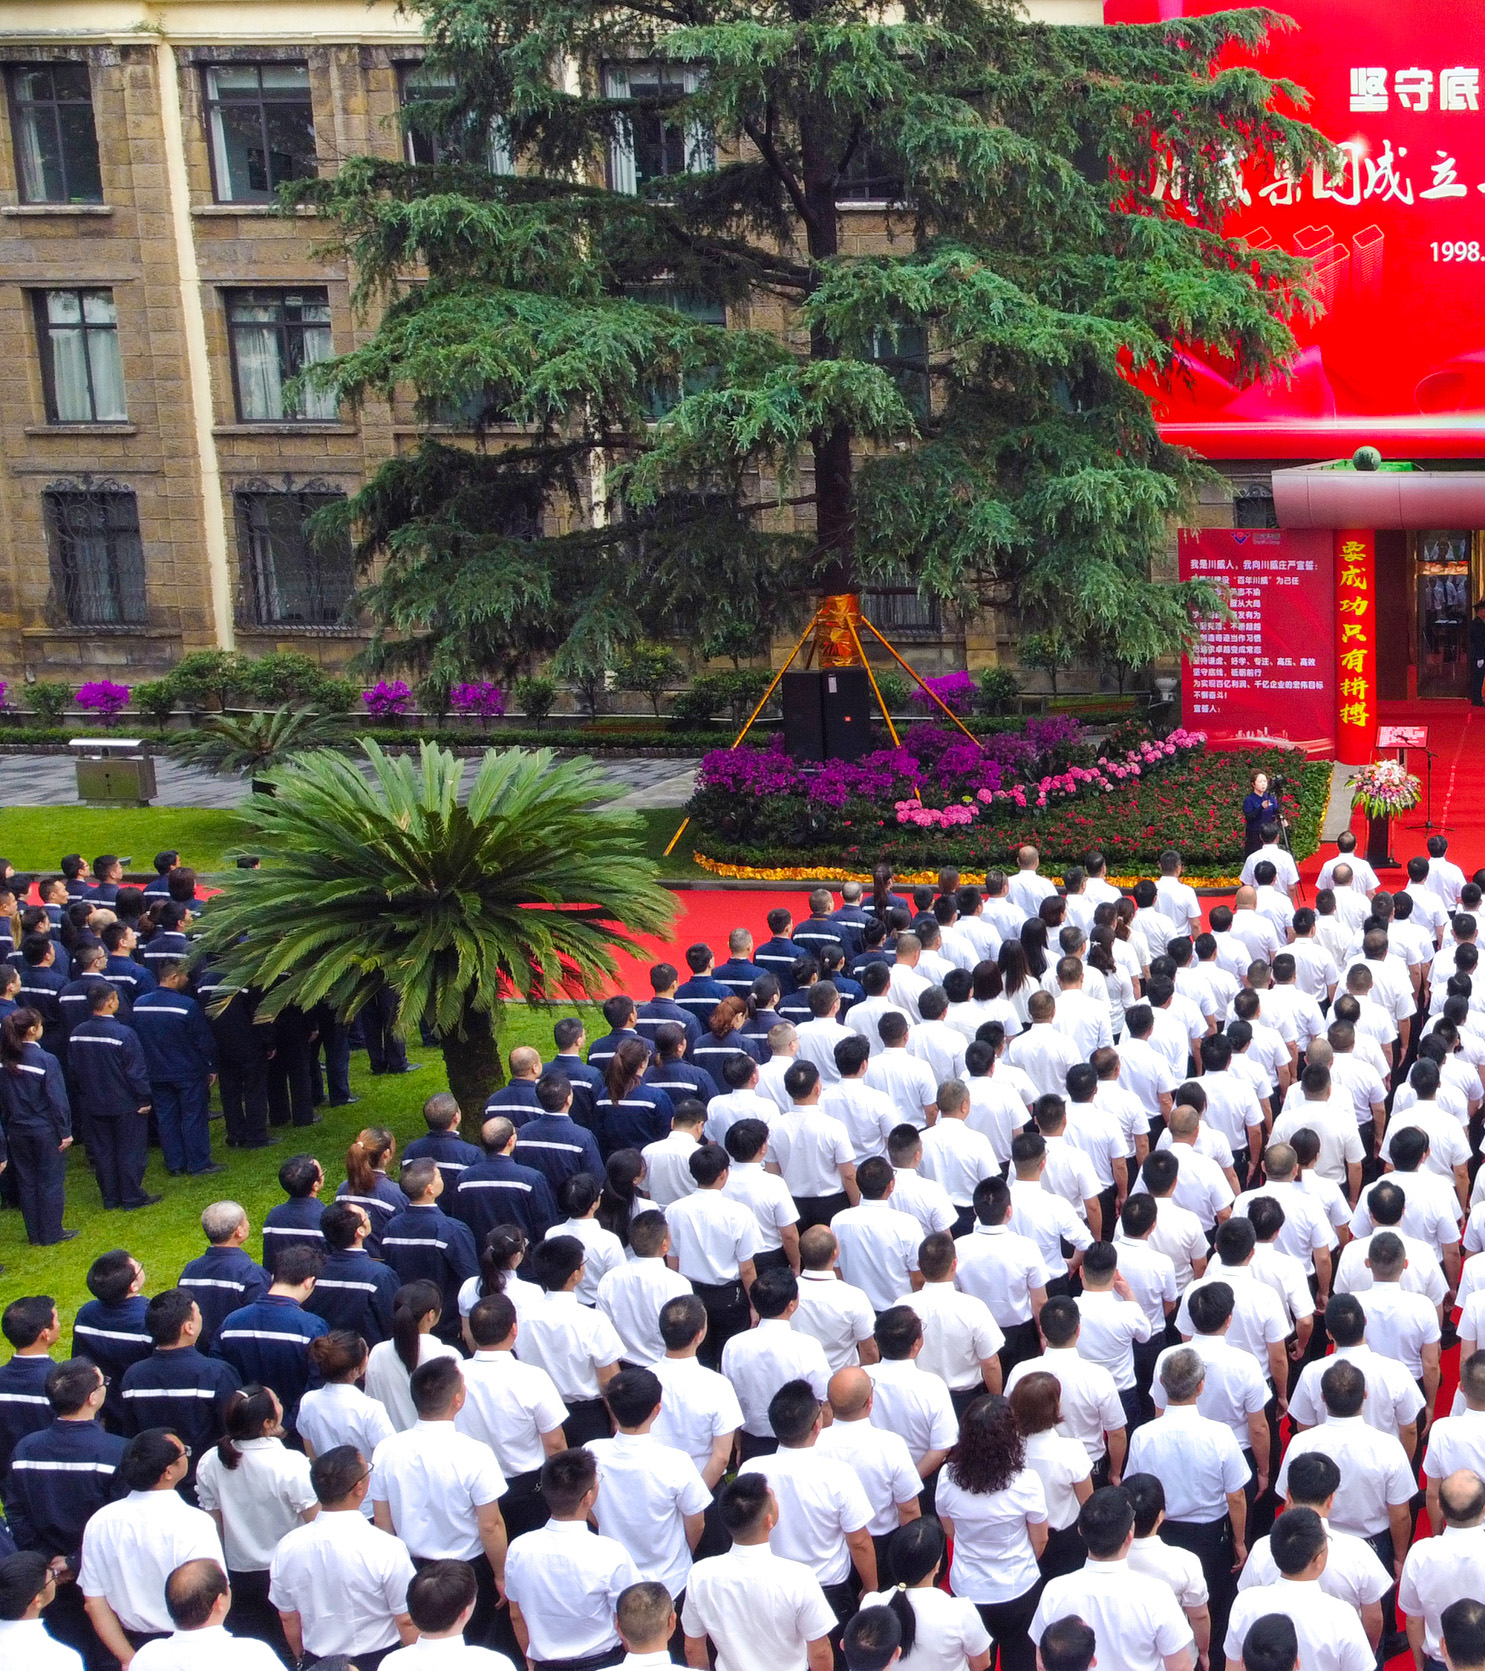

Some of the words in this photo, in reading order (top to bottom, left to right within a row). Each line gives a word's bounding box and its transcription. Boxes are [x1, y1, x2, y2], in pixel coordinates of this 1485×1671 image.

[1339, 540, 1370, 728] 要成功只有拼搏
